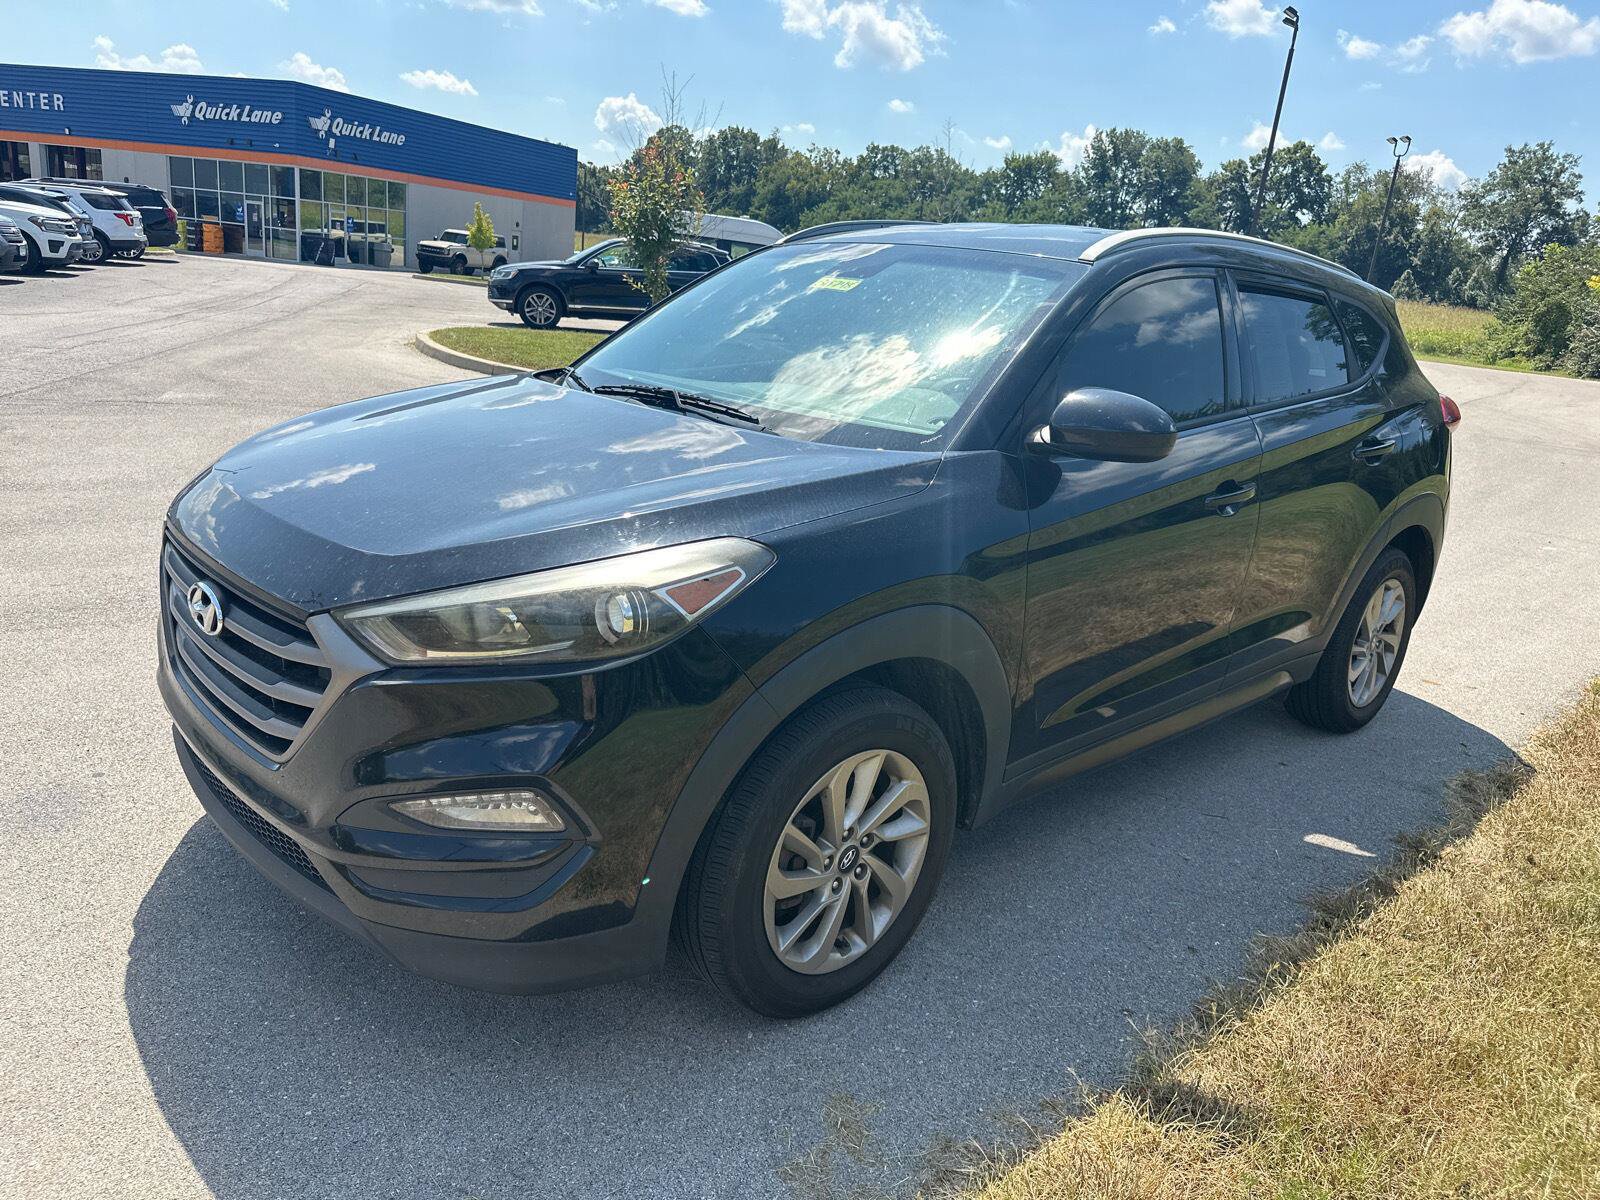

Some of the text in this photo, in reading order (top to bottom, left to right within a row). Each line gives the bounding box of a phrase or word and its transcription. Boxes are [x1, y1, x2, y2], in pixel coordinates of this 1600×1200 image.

[0, 90, 64, 111] ENTER
[194, 101, 282, 125] Quick Lane
[332, 117, 406, 146] Quick Lane
